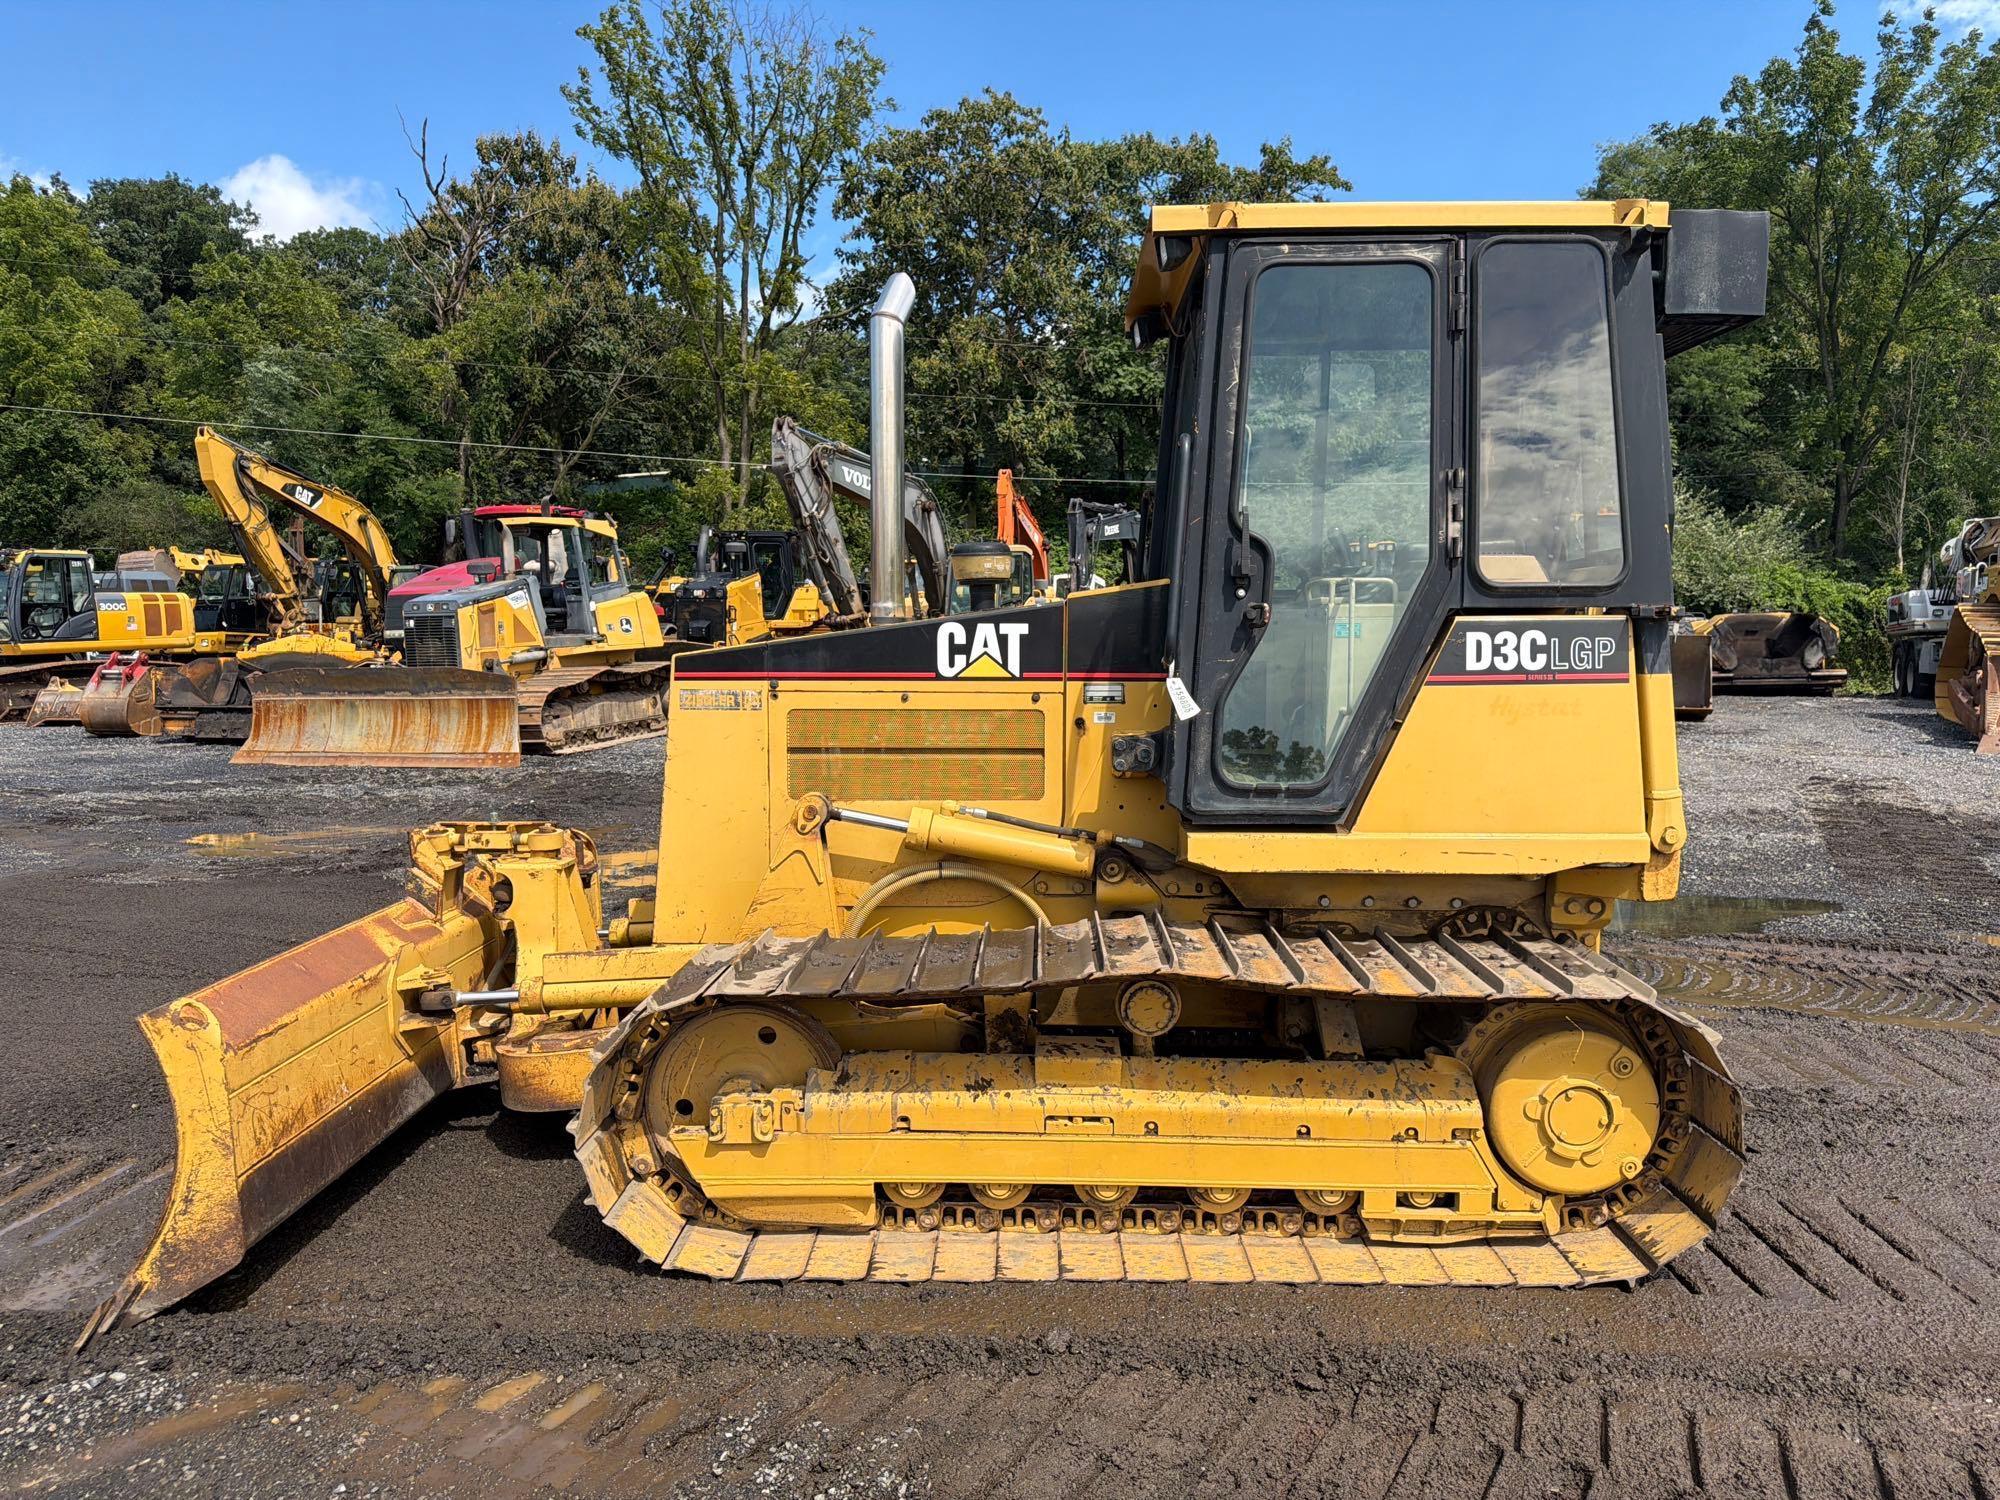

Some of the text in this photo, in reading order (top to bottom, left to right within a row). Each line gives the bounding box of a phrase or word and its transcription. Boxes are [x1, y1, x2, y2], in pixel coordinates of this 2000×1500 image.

[842, 465, 871, 490] VOL
[295, 485, 315, 506] CAT
[99, 602, 126, 611] 300G
[937, 622, 1029, 677] CAT
